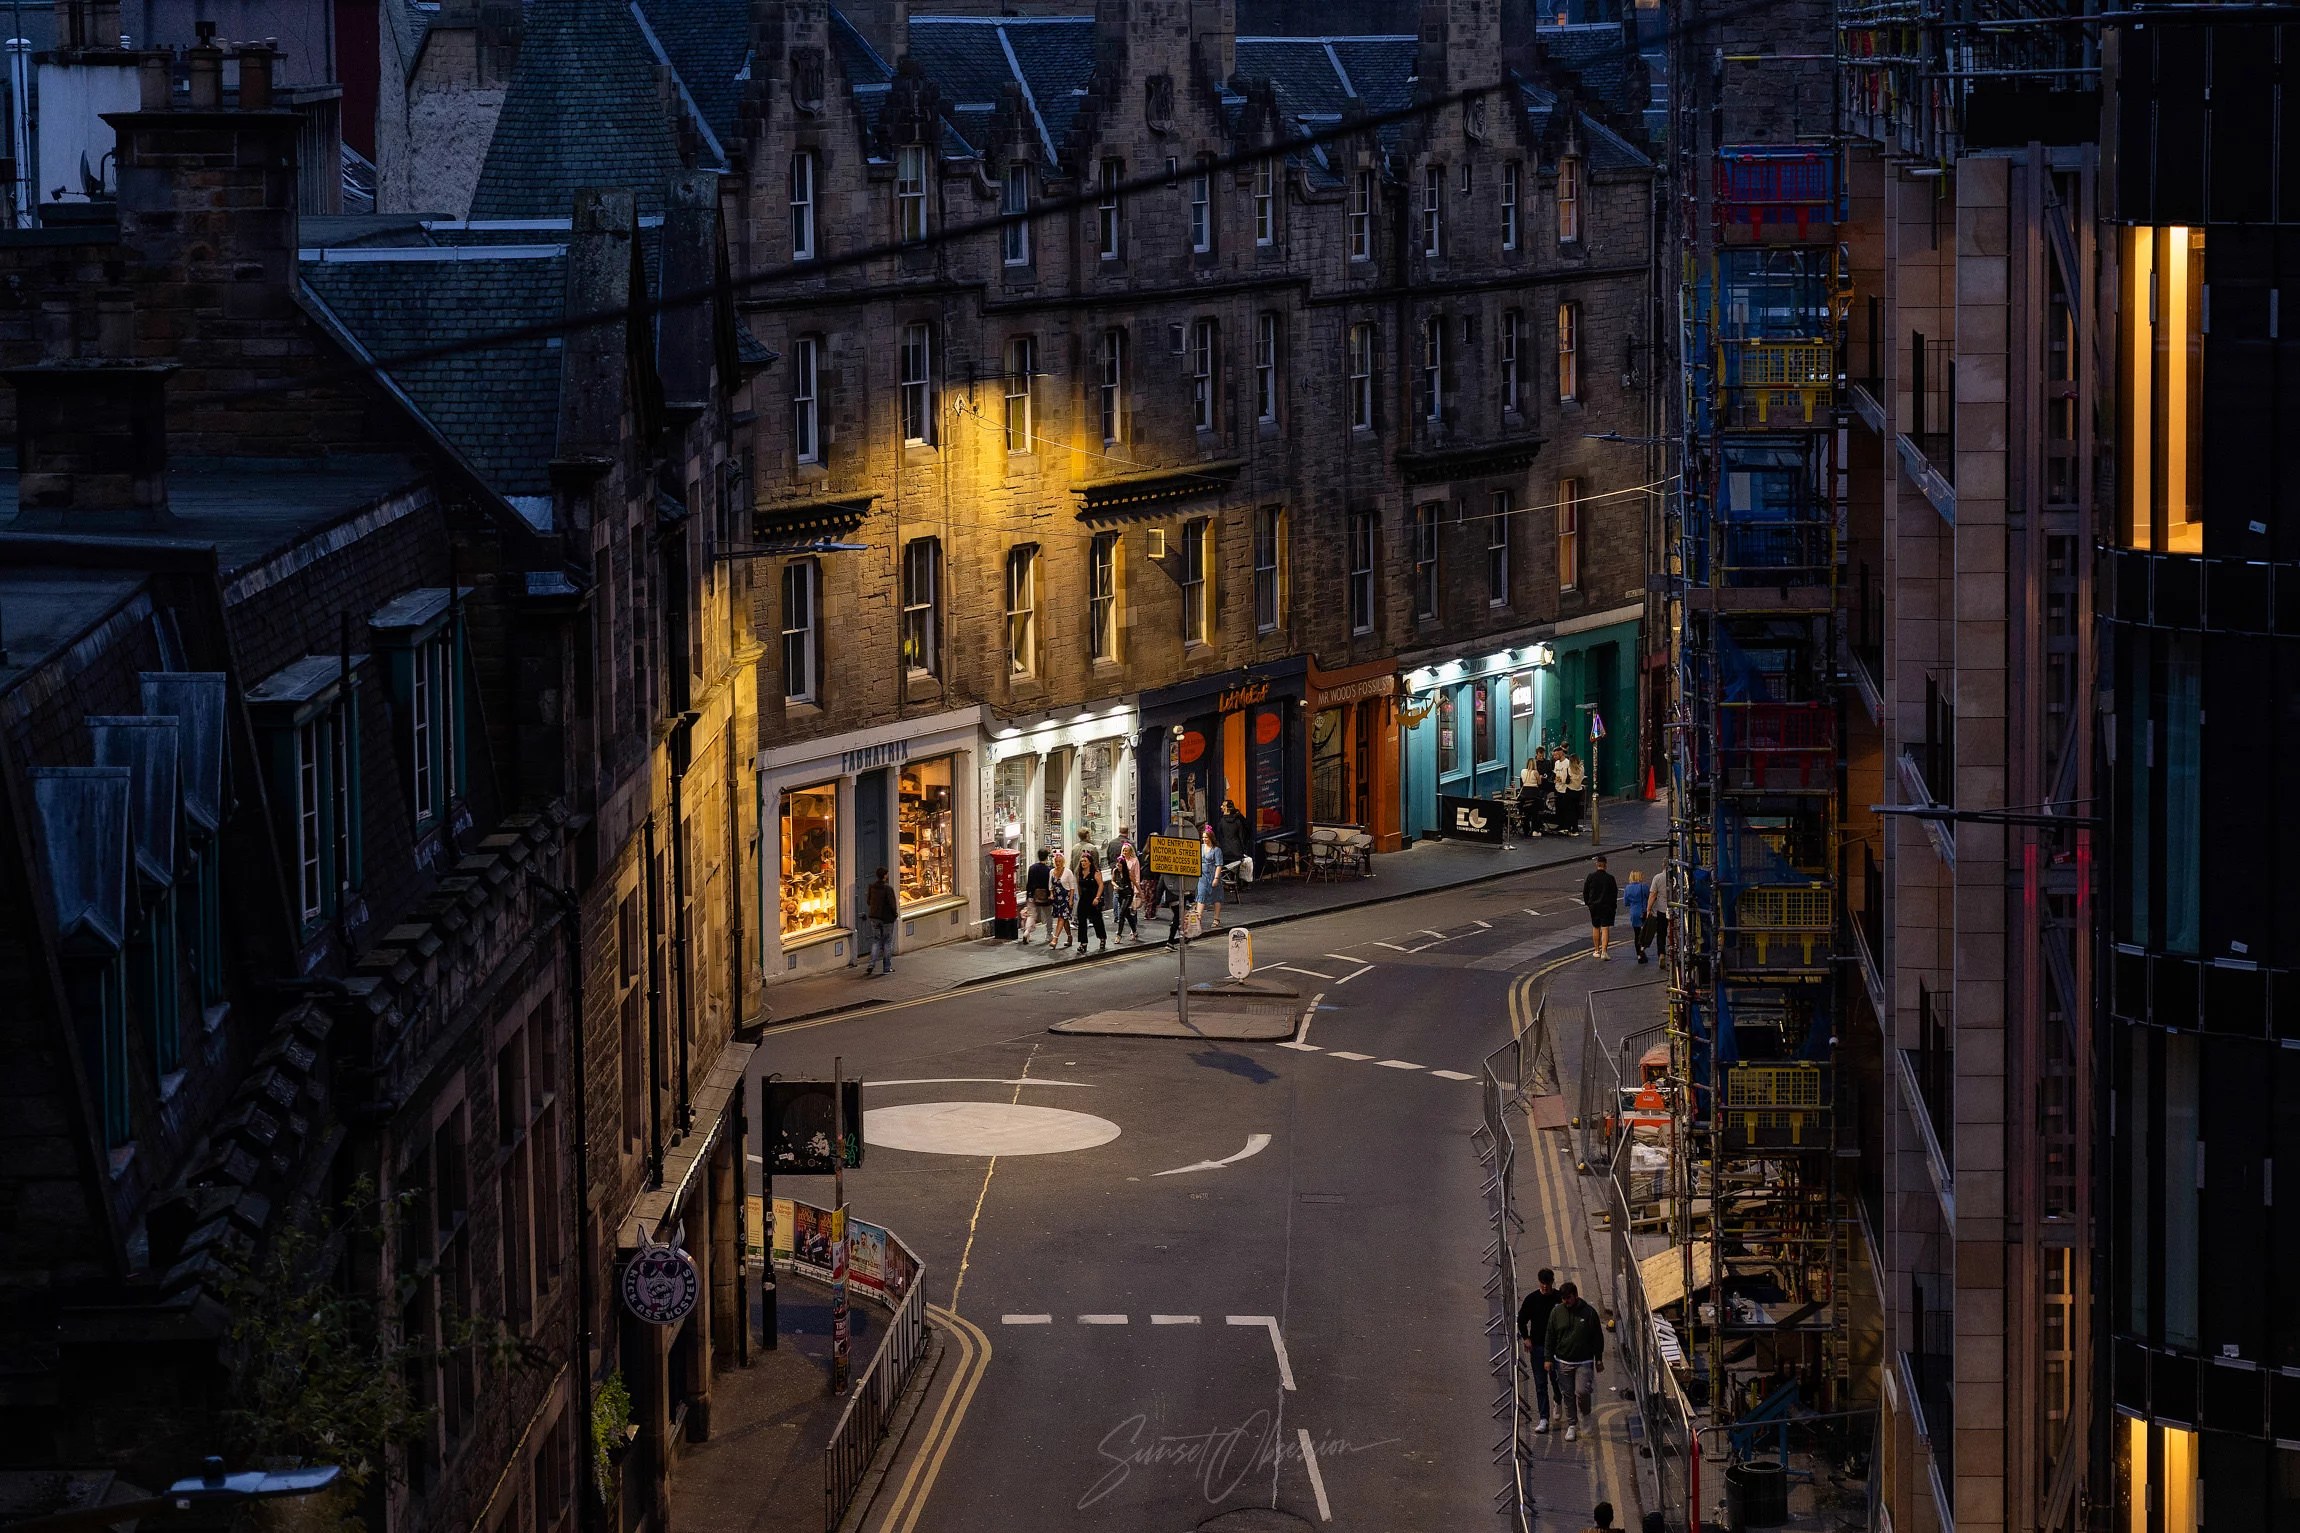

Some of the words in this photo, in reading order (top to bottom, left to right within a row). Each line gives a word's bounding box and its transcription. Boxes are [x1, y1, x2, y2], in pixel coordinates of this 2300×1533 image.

[1318, 691, 1329, 705] MR
[1358, 678, 1387, 697] FOSSILS
[842, 739, 908, 773] FABHATRIX
[1168, 839, 1184, 848] ENTRY
[1186, 840, 1194, 849] TO
[1153, 846, 1177, 855] VICTORIA
[1179, 848, 1199, 857] STREET
[1153, 854, 1172, 863] LOADING
[1173, 856, 1191, 865] ACCESS
[1156, 863, 1173, 872] GEORGE
[627, 1269, 638, 1303] KICK
[636, 1304, 660, 1320] ASS
[665, 1269, 695, 1320] HOSTELS
